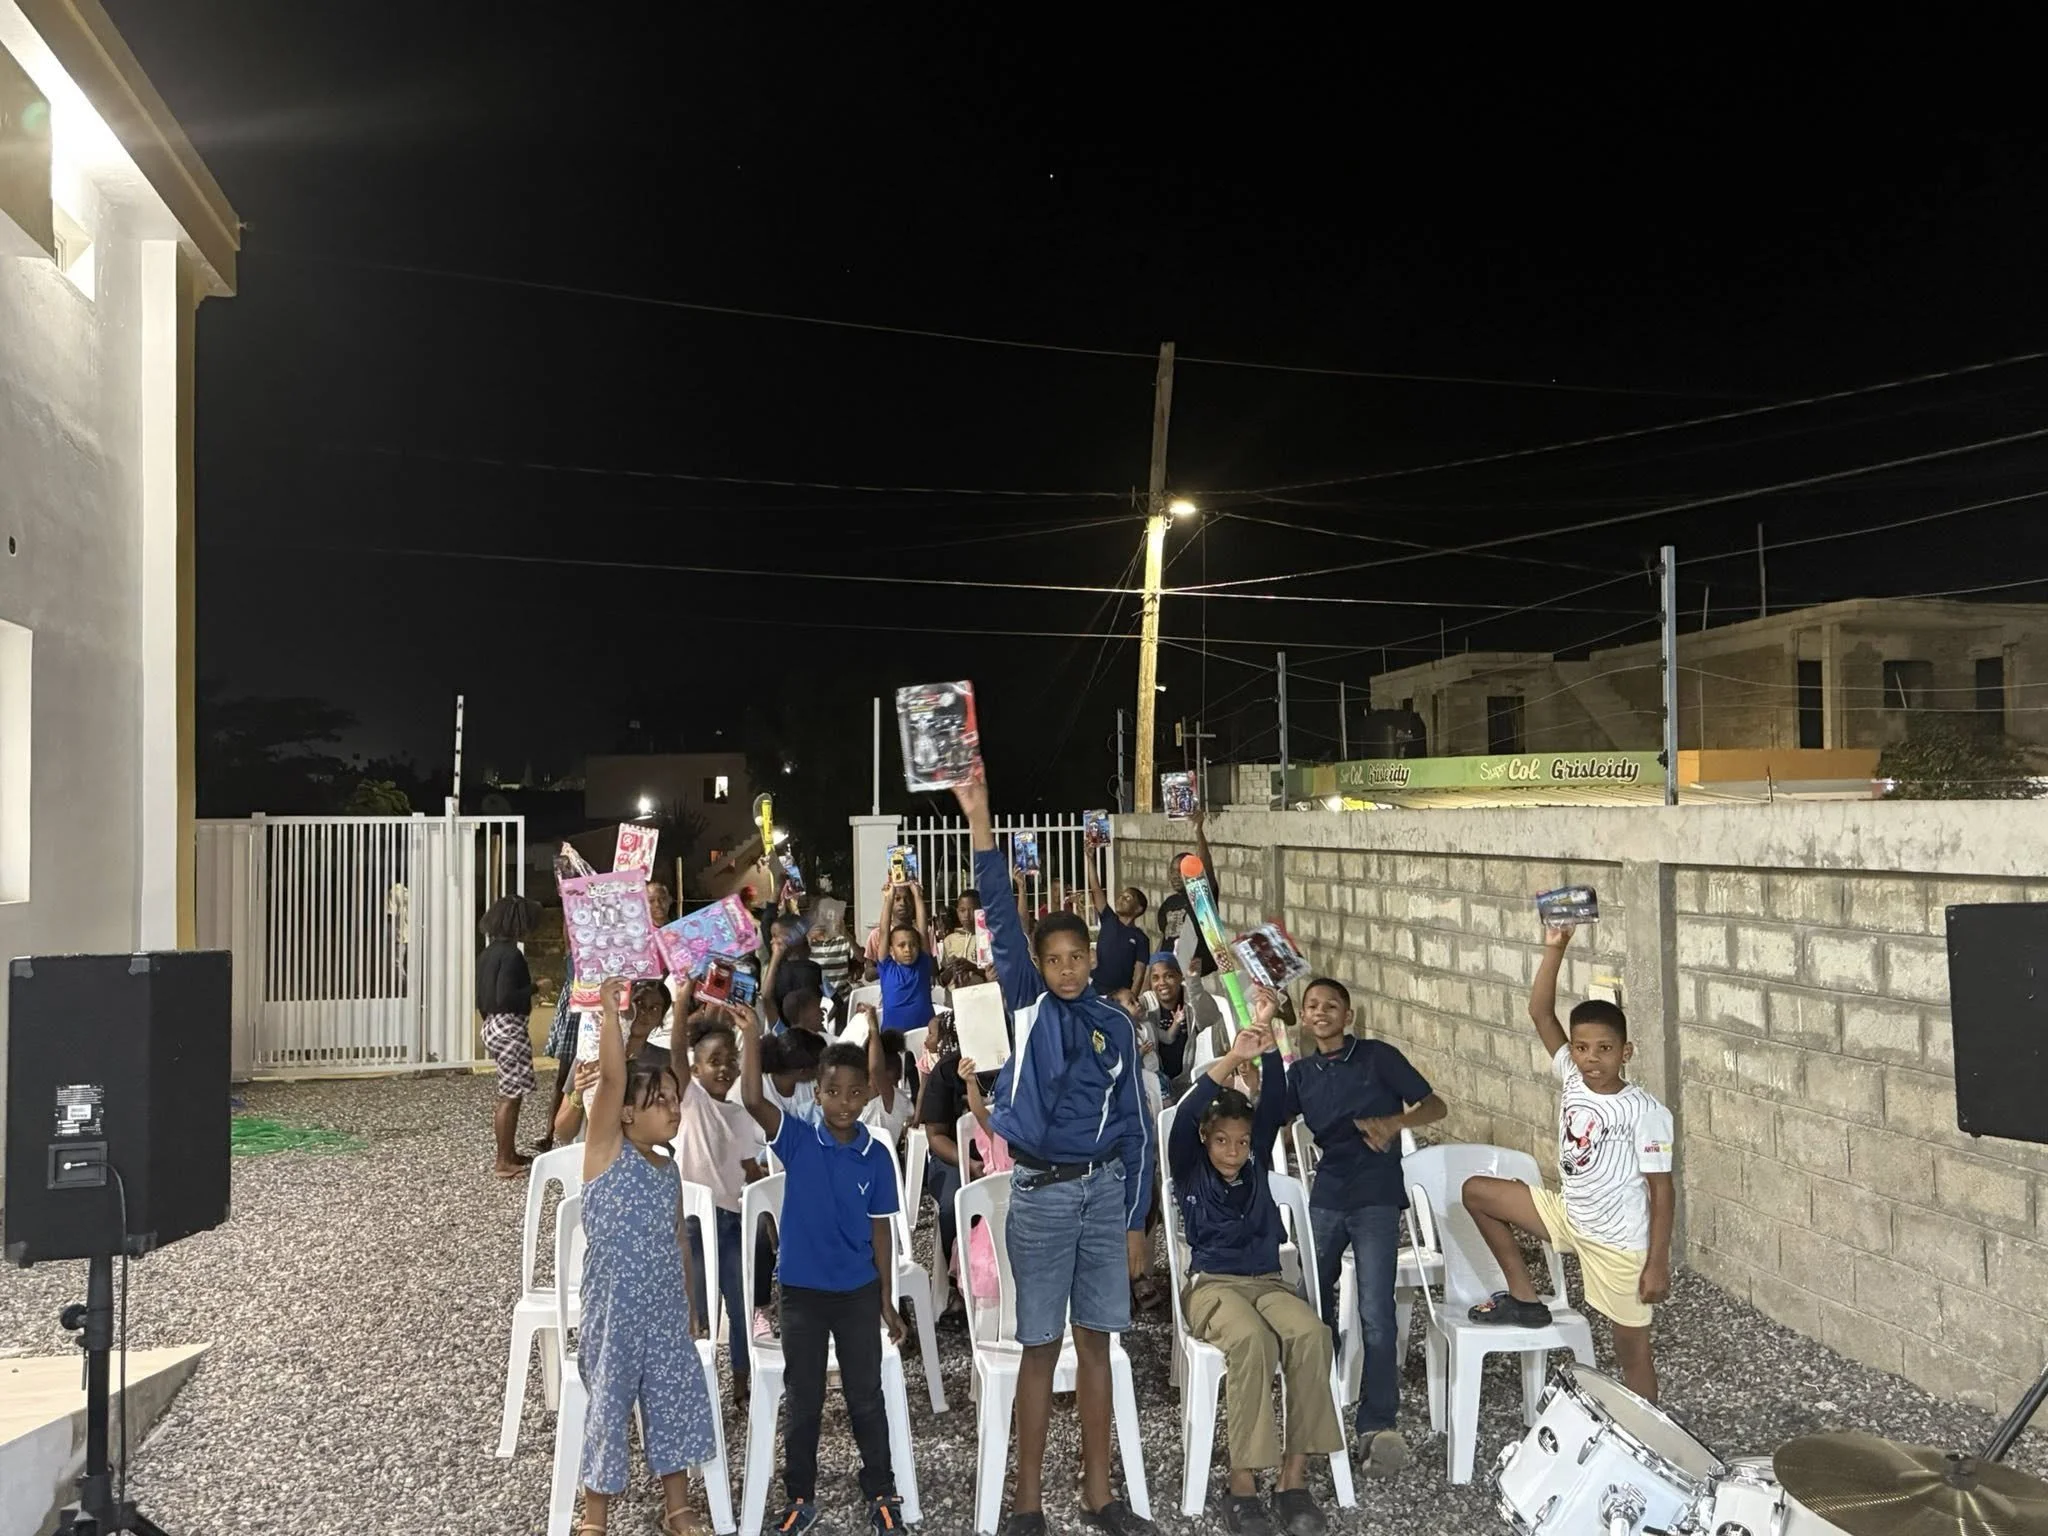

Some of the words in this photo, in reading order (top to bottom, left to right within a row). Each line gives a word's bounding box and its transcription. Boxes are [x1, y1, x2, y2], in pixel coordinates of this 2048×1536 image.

[1480, 762, 1508, 781] Super
[1508, 758, 1541, 781] Col.
[1551, 757, 1640, 784] Grisleidy
